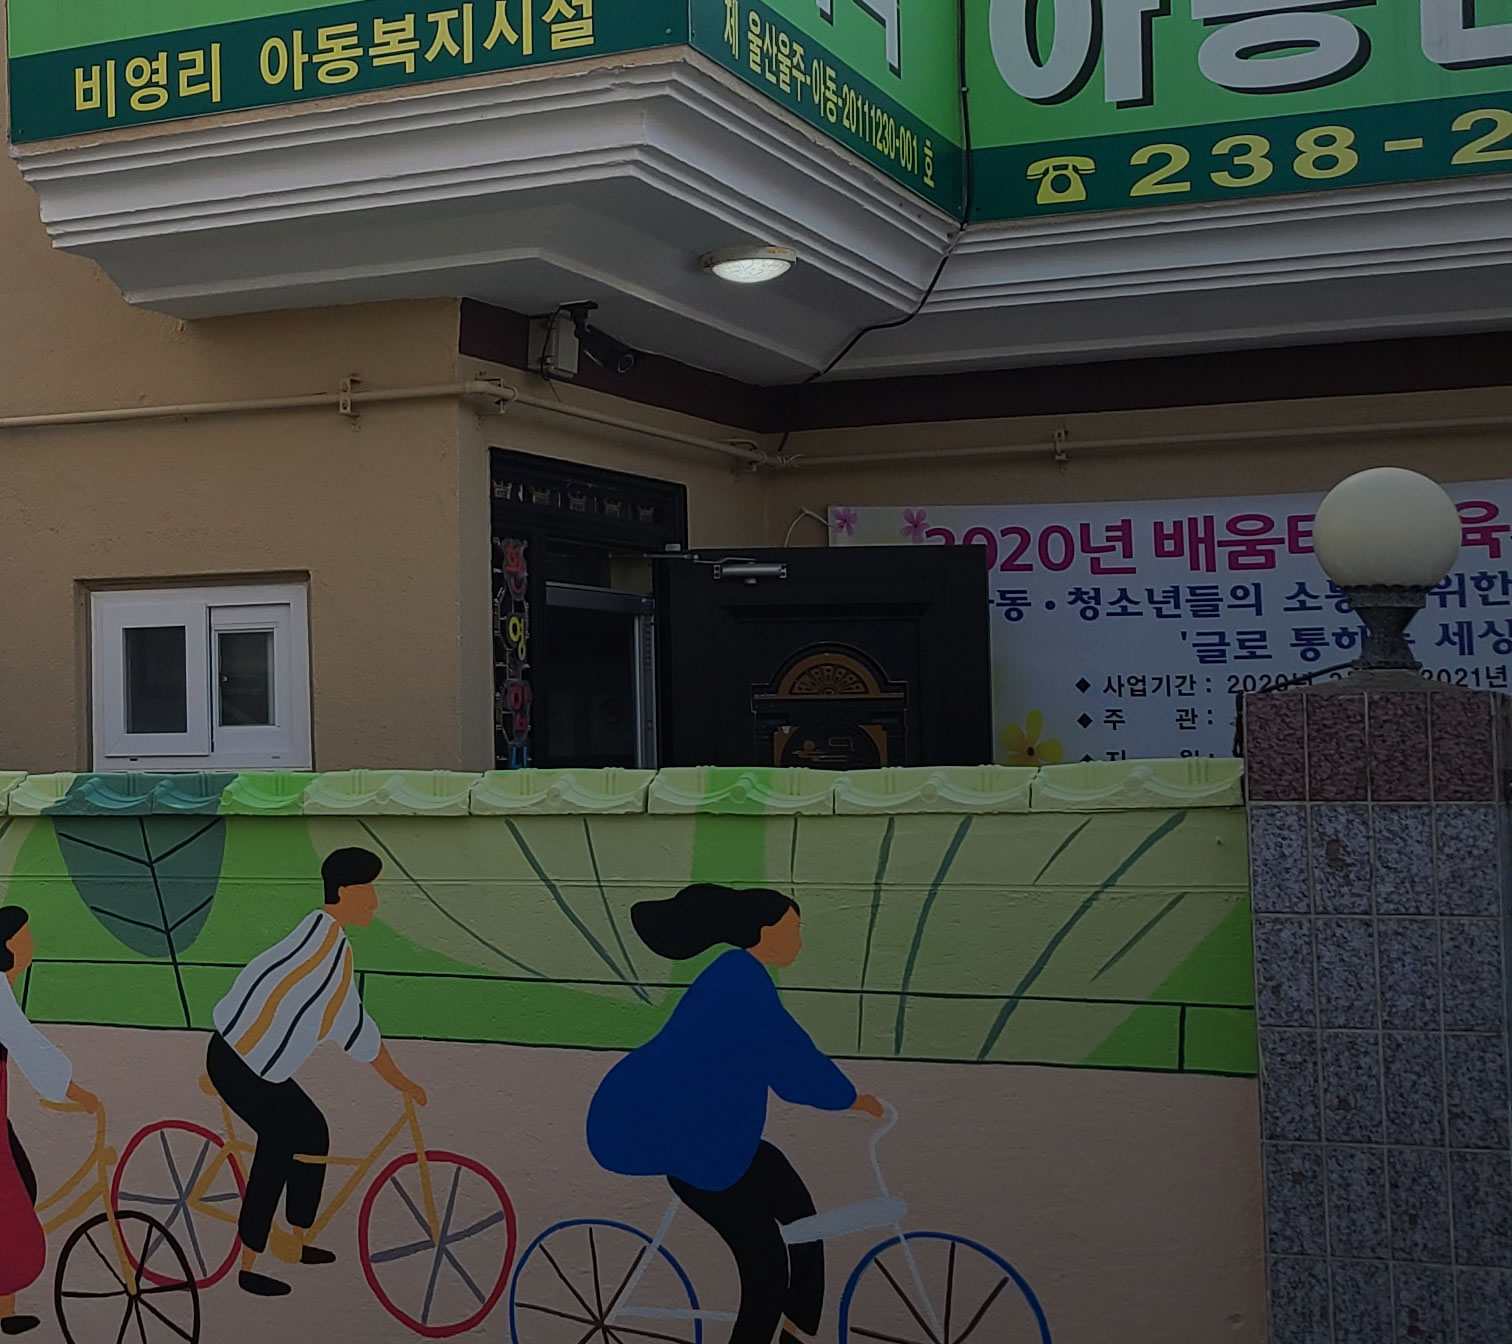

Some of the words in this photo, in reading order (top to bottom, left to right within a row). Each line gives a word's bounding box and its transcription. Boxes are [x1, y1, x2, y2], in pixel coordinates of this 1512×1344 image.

[74, 42, 222, 118] 비영리
[923, 138, 935, 188] 호
[1103, 709, 1125, 730] 주
